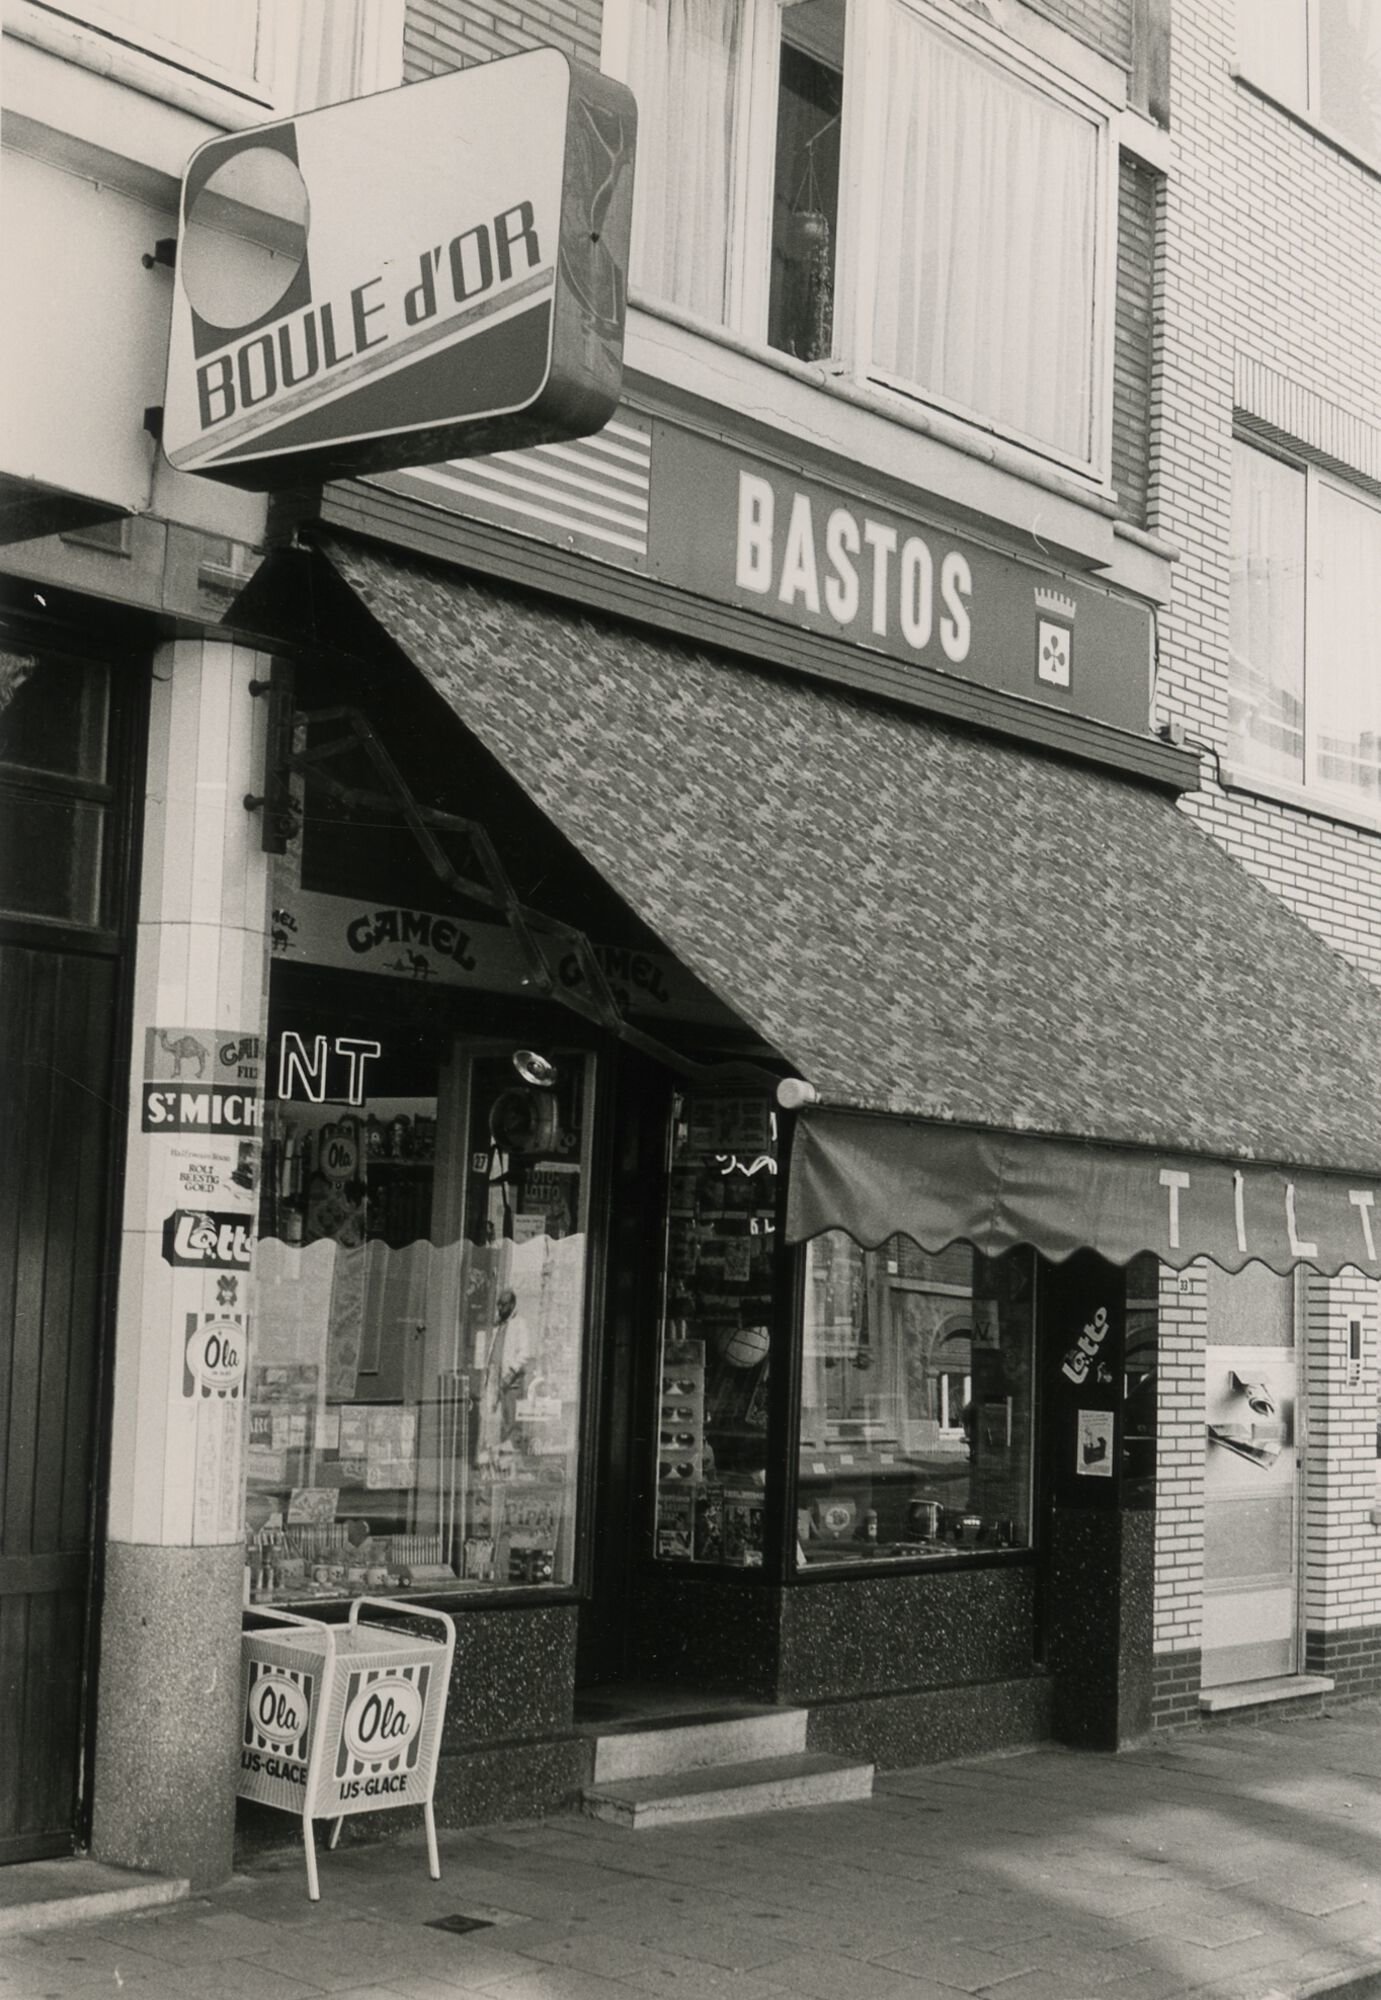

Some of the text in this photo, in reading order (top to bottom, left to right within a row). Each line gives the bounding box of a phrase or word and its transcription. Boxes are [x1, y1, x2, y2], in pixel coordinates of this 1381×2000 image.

[196, 200, 541, 430] BOULE d'OR
[736, 470, 972, 662] BASTOS
[346, 909, 476, 971] CAMEL
[278, 1031, 381, 1106] NT
[180, 1093, 265, 1128] MICH
[329, 1142, 352, 1169] Ola
[1159, 1168, 1378, 1261] TILT
[1180, 1279, 1188, 1292] 33
[205, 1334, 240, 1369] Ola
[1062, 1307, 1110, 1385] Lotto
[259, 1685, 300, 1730] Ola
[358, 1693, 410, 1743] Ola
[339, 1774, 408, 1801] IJS-GLACE
